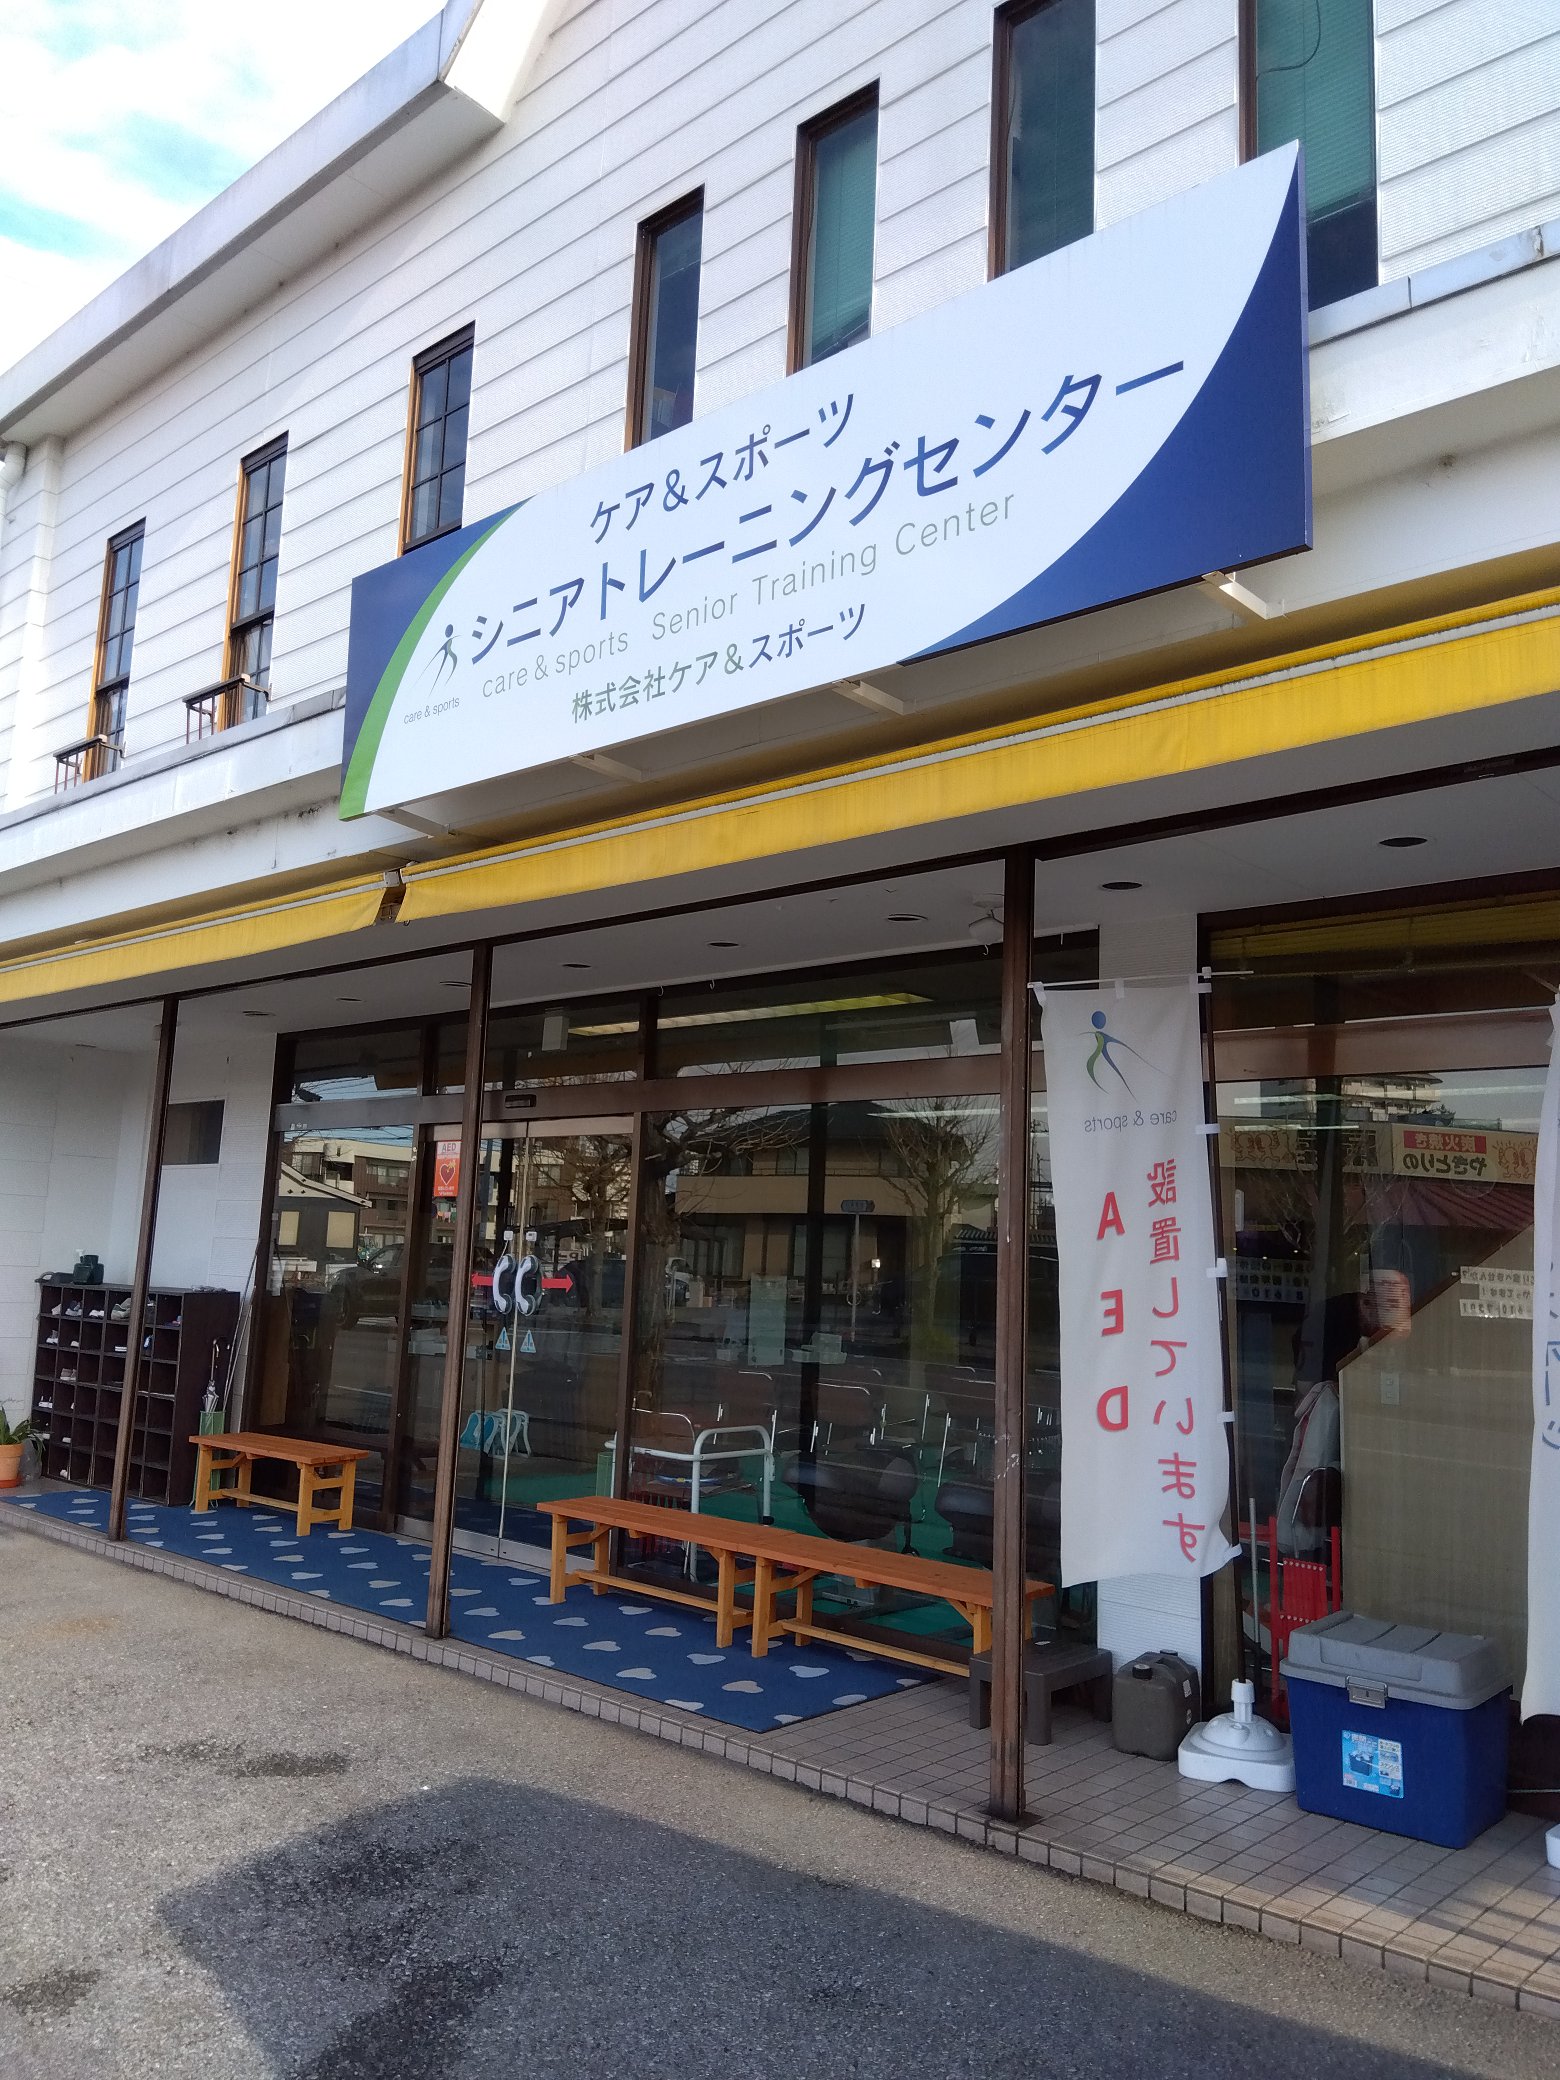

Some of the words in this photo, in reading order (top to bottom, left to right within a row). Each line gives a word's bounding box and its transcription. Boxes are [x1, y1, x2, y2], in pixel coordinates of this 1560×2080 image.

[471, 360, 1184, 665] シニアトレーニングセンター
[590, 393, 854, 544] ケア&スポーツ
[482, 667, 527, 698] care
[534, 655, 549, 681] &
[555, 631, 629, 675] sports
[652, 593, 738, 641] Senior
[752, 543, 877, 606] Training
[895, 494, 1014, 556] Center
[571, 603, 865, 724] 株式会社ケア&スポーツ
[403, 709, 422, 724] care
[433, 697, 460, 716] sports
[442, 1142, 457, 1153] AED
